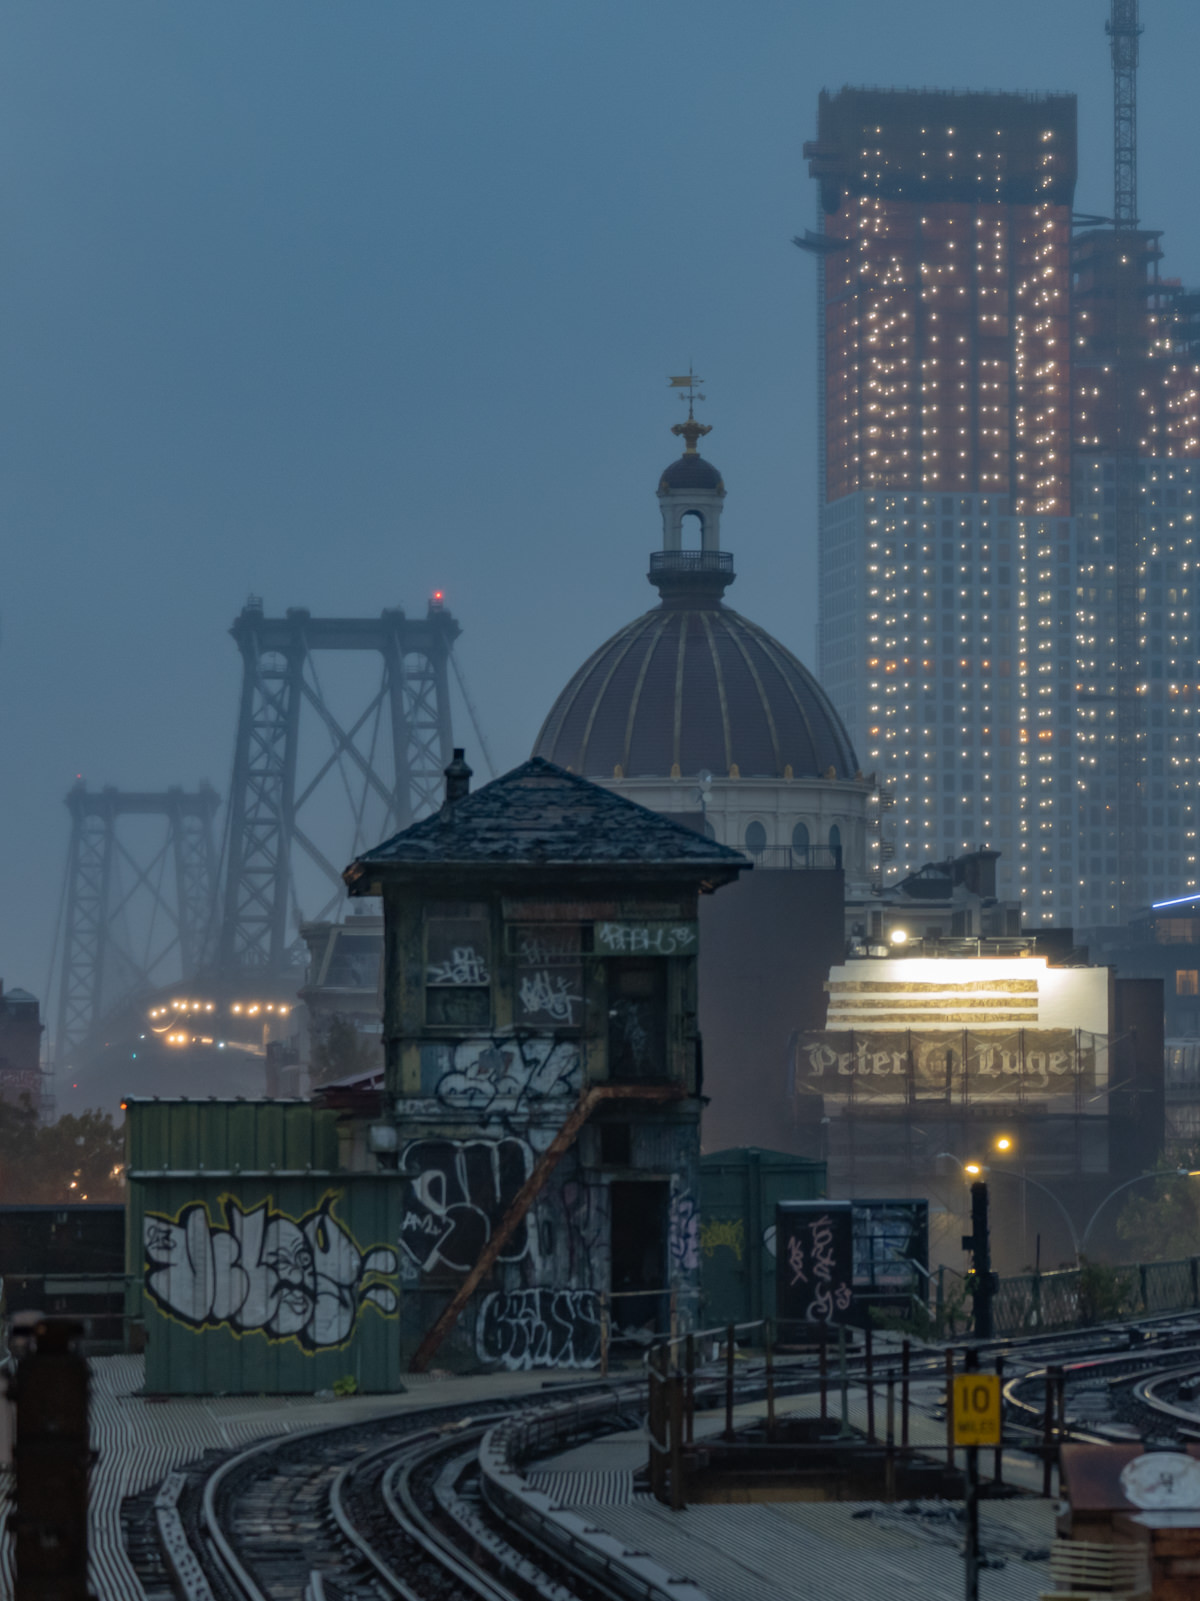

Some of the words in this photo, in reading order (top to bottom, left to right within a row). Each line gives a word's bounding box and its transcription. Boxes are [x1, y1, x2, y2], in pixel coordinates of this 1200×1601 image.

[803, 1041, 908, 1077] Peter
[974, 1042, 1088, 1088] Luger
[962, 1386, 990, 1414] 10
